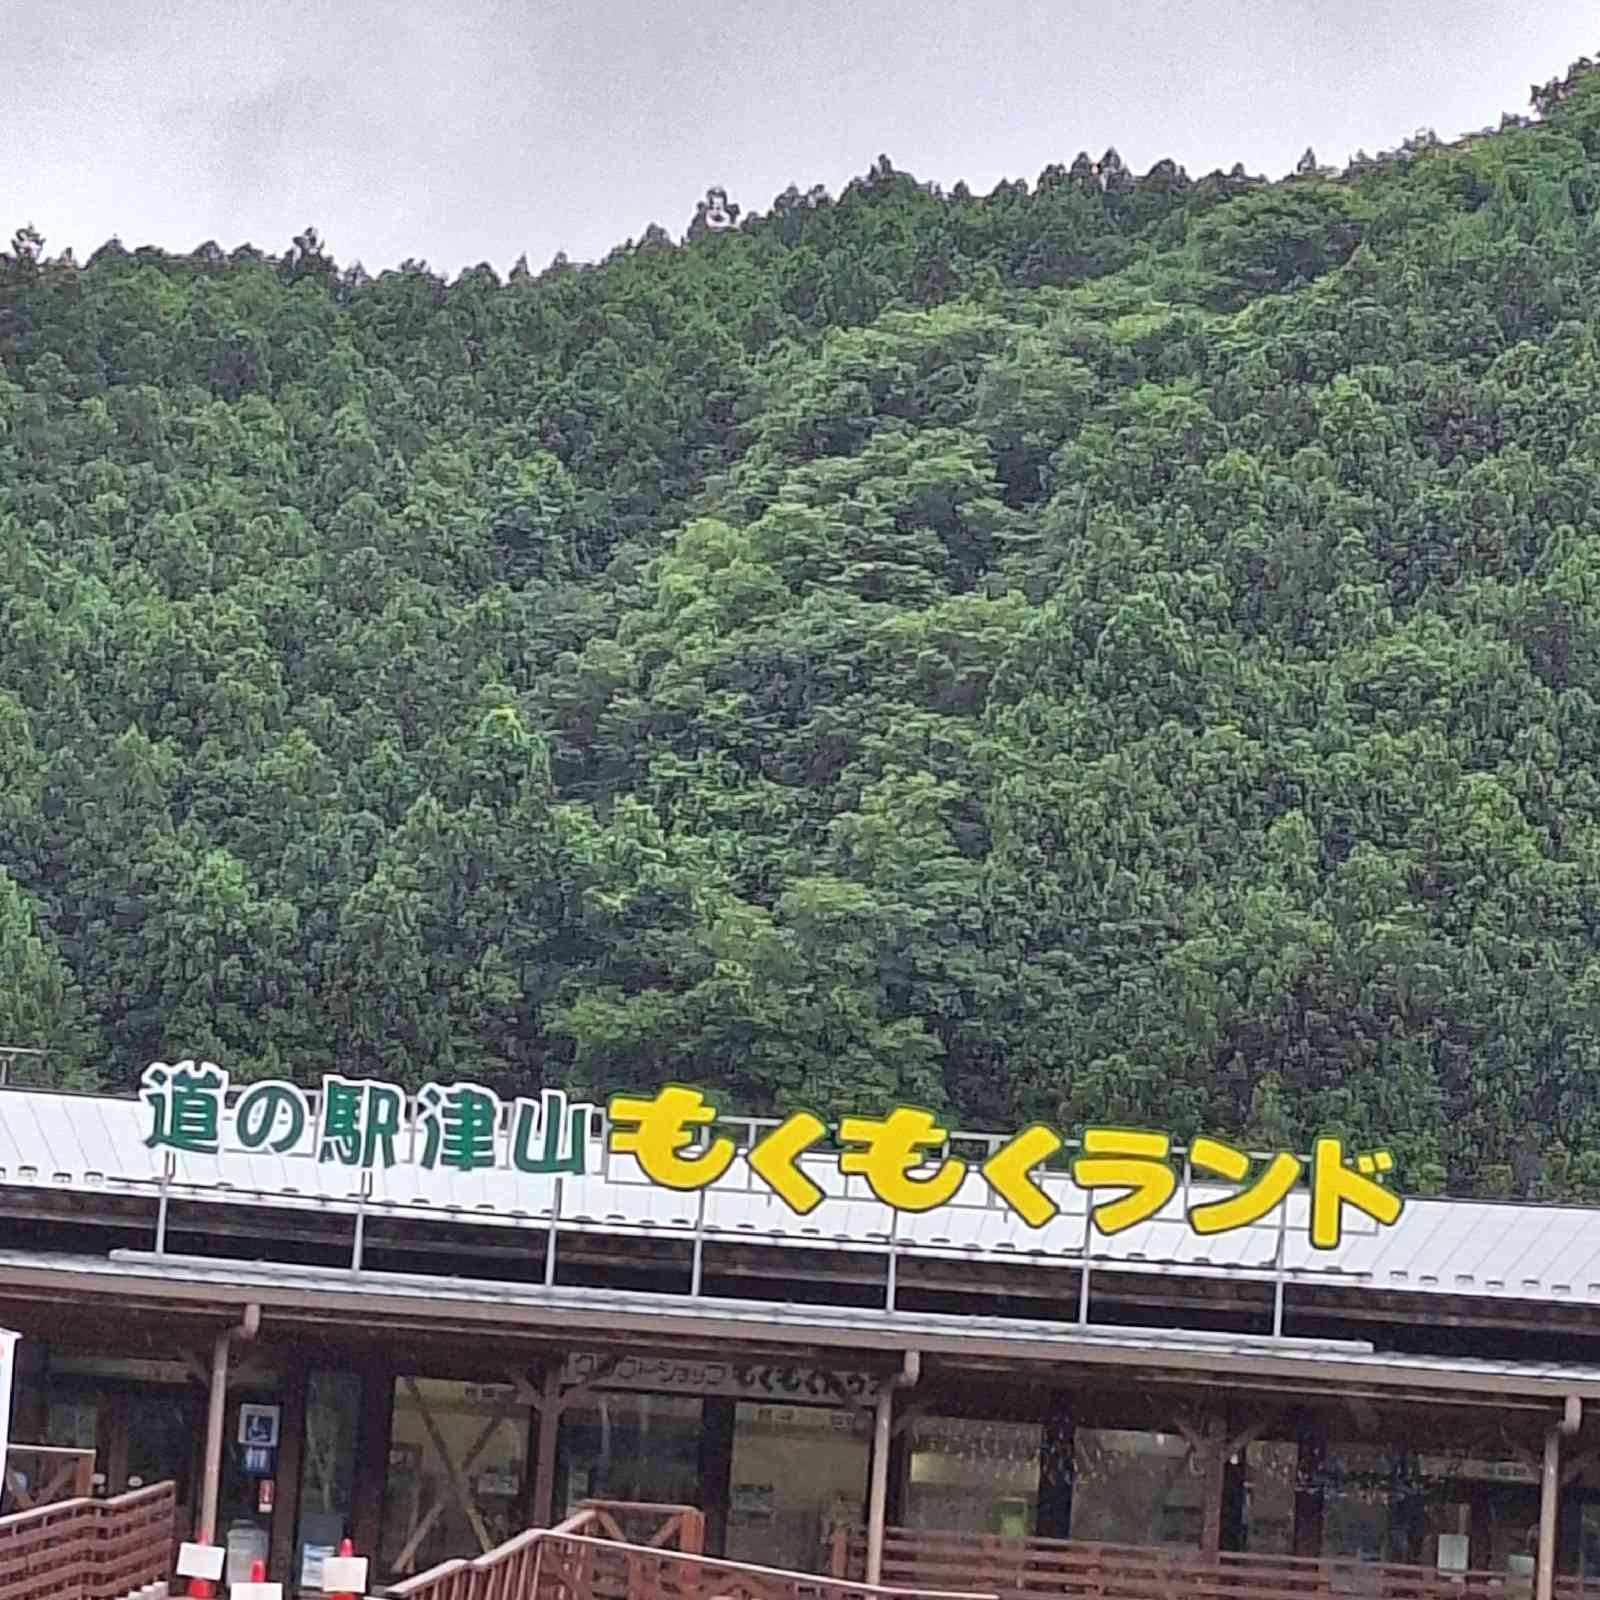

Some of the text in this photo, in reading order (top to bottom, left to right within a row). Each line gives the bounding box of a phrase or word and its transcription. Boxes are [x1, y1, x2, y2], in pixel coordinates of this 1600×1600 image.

[141, 1064, 1404, 1249] 道の駅津山 もくもくランド
